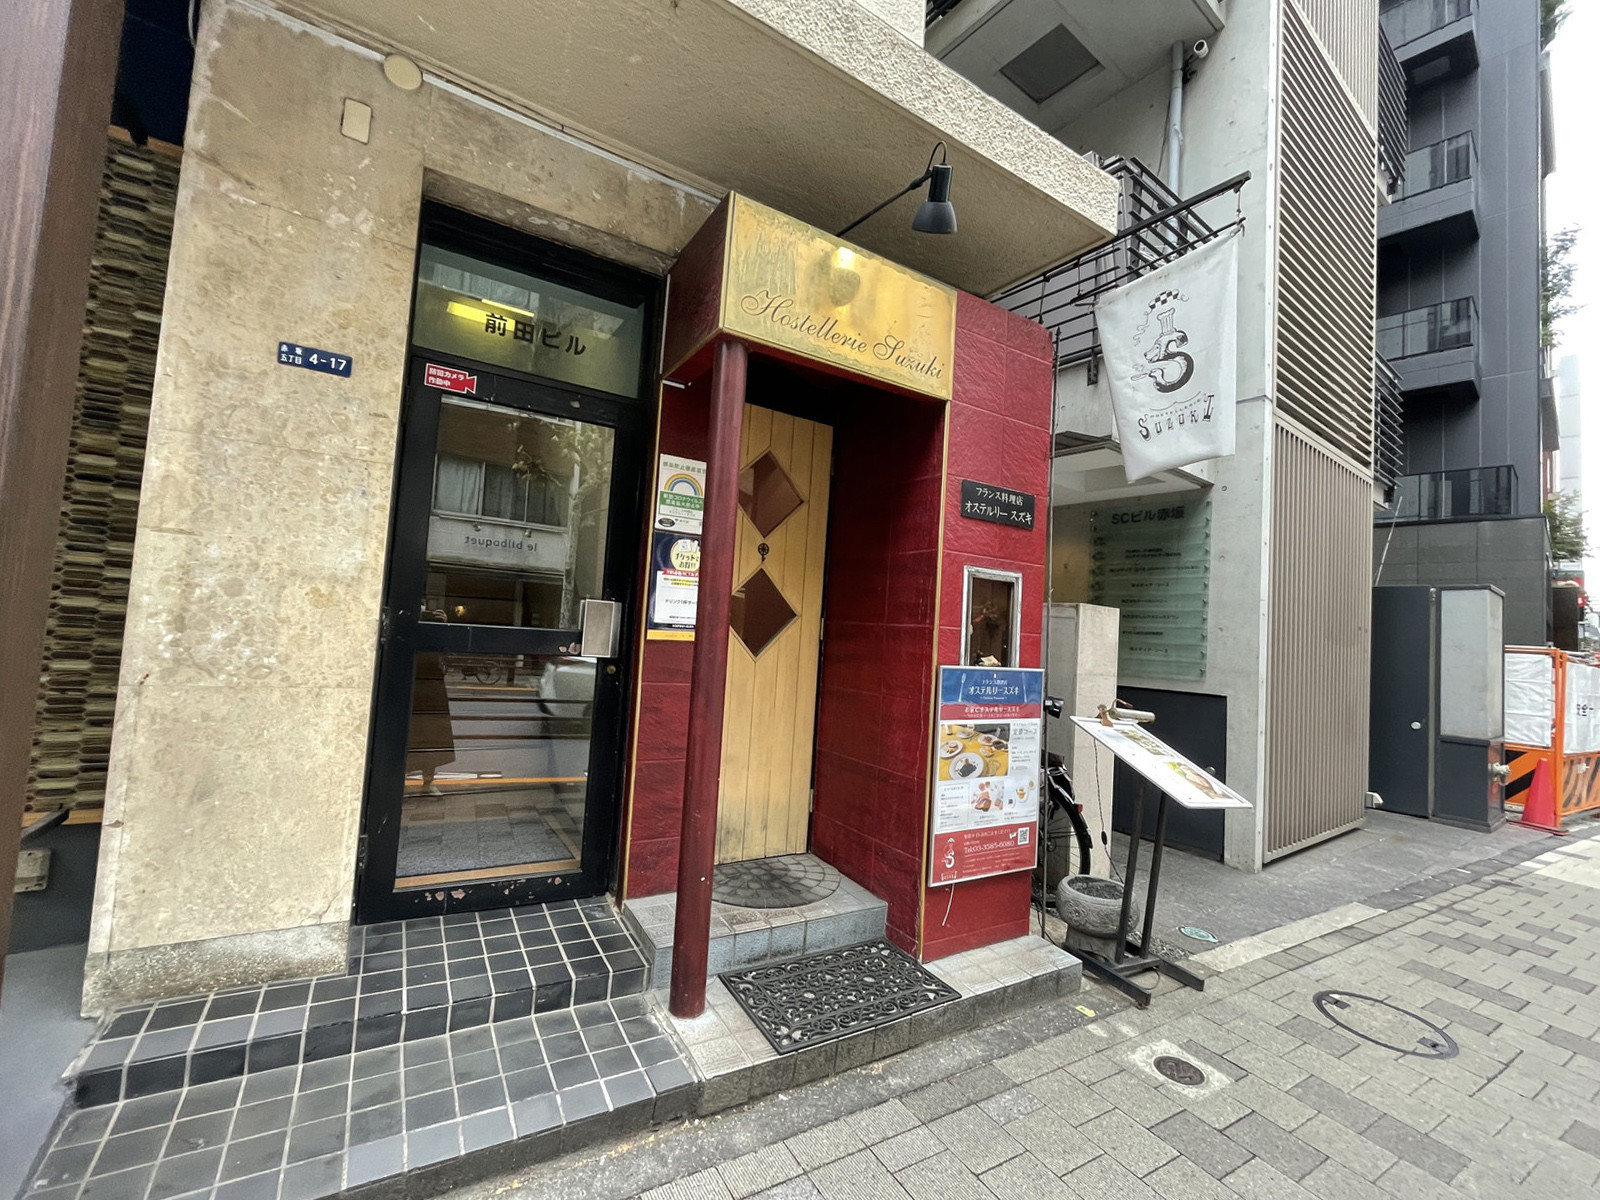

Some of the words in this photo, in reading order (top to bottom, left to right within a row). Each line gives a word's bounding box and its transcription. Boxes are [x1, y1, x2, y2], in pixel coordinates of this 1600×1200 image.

[485, 313, 586, 356] 前田ビル
[740, 289, 867, 353] Hostellerie
[872, 334, 945, 380] Suzuki
[280, 353, 303, 365] 五丁目
[308, 353, 347, 371] 4-17
[1138, 394, 1215, 442] SUZUKI
[976, 487, 1024, 506] フランス料理店
[965, 500, 1008, 518] オステルリー
[1010, 510, 1032, 525] スズキ
